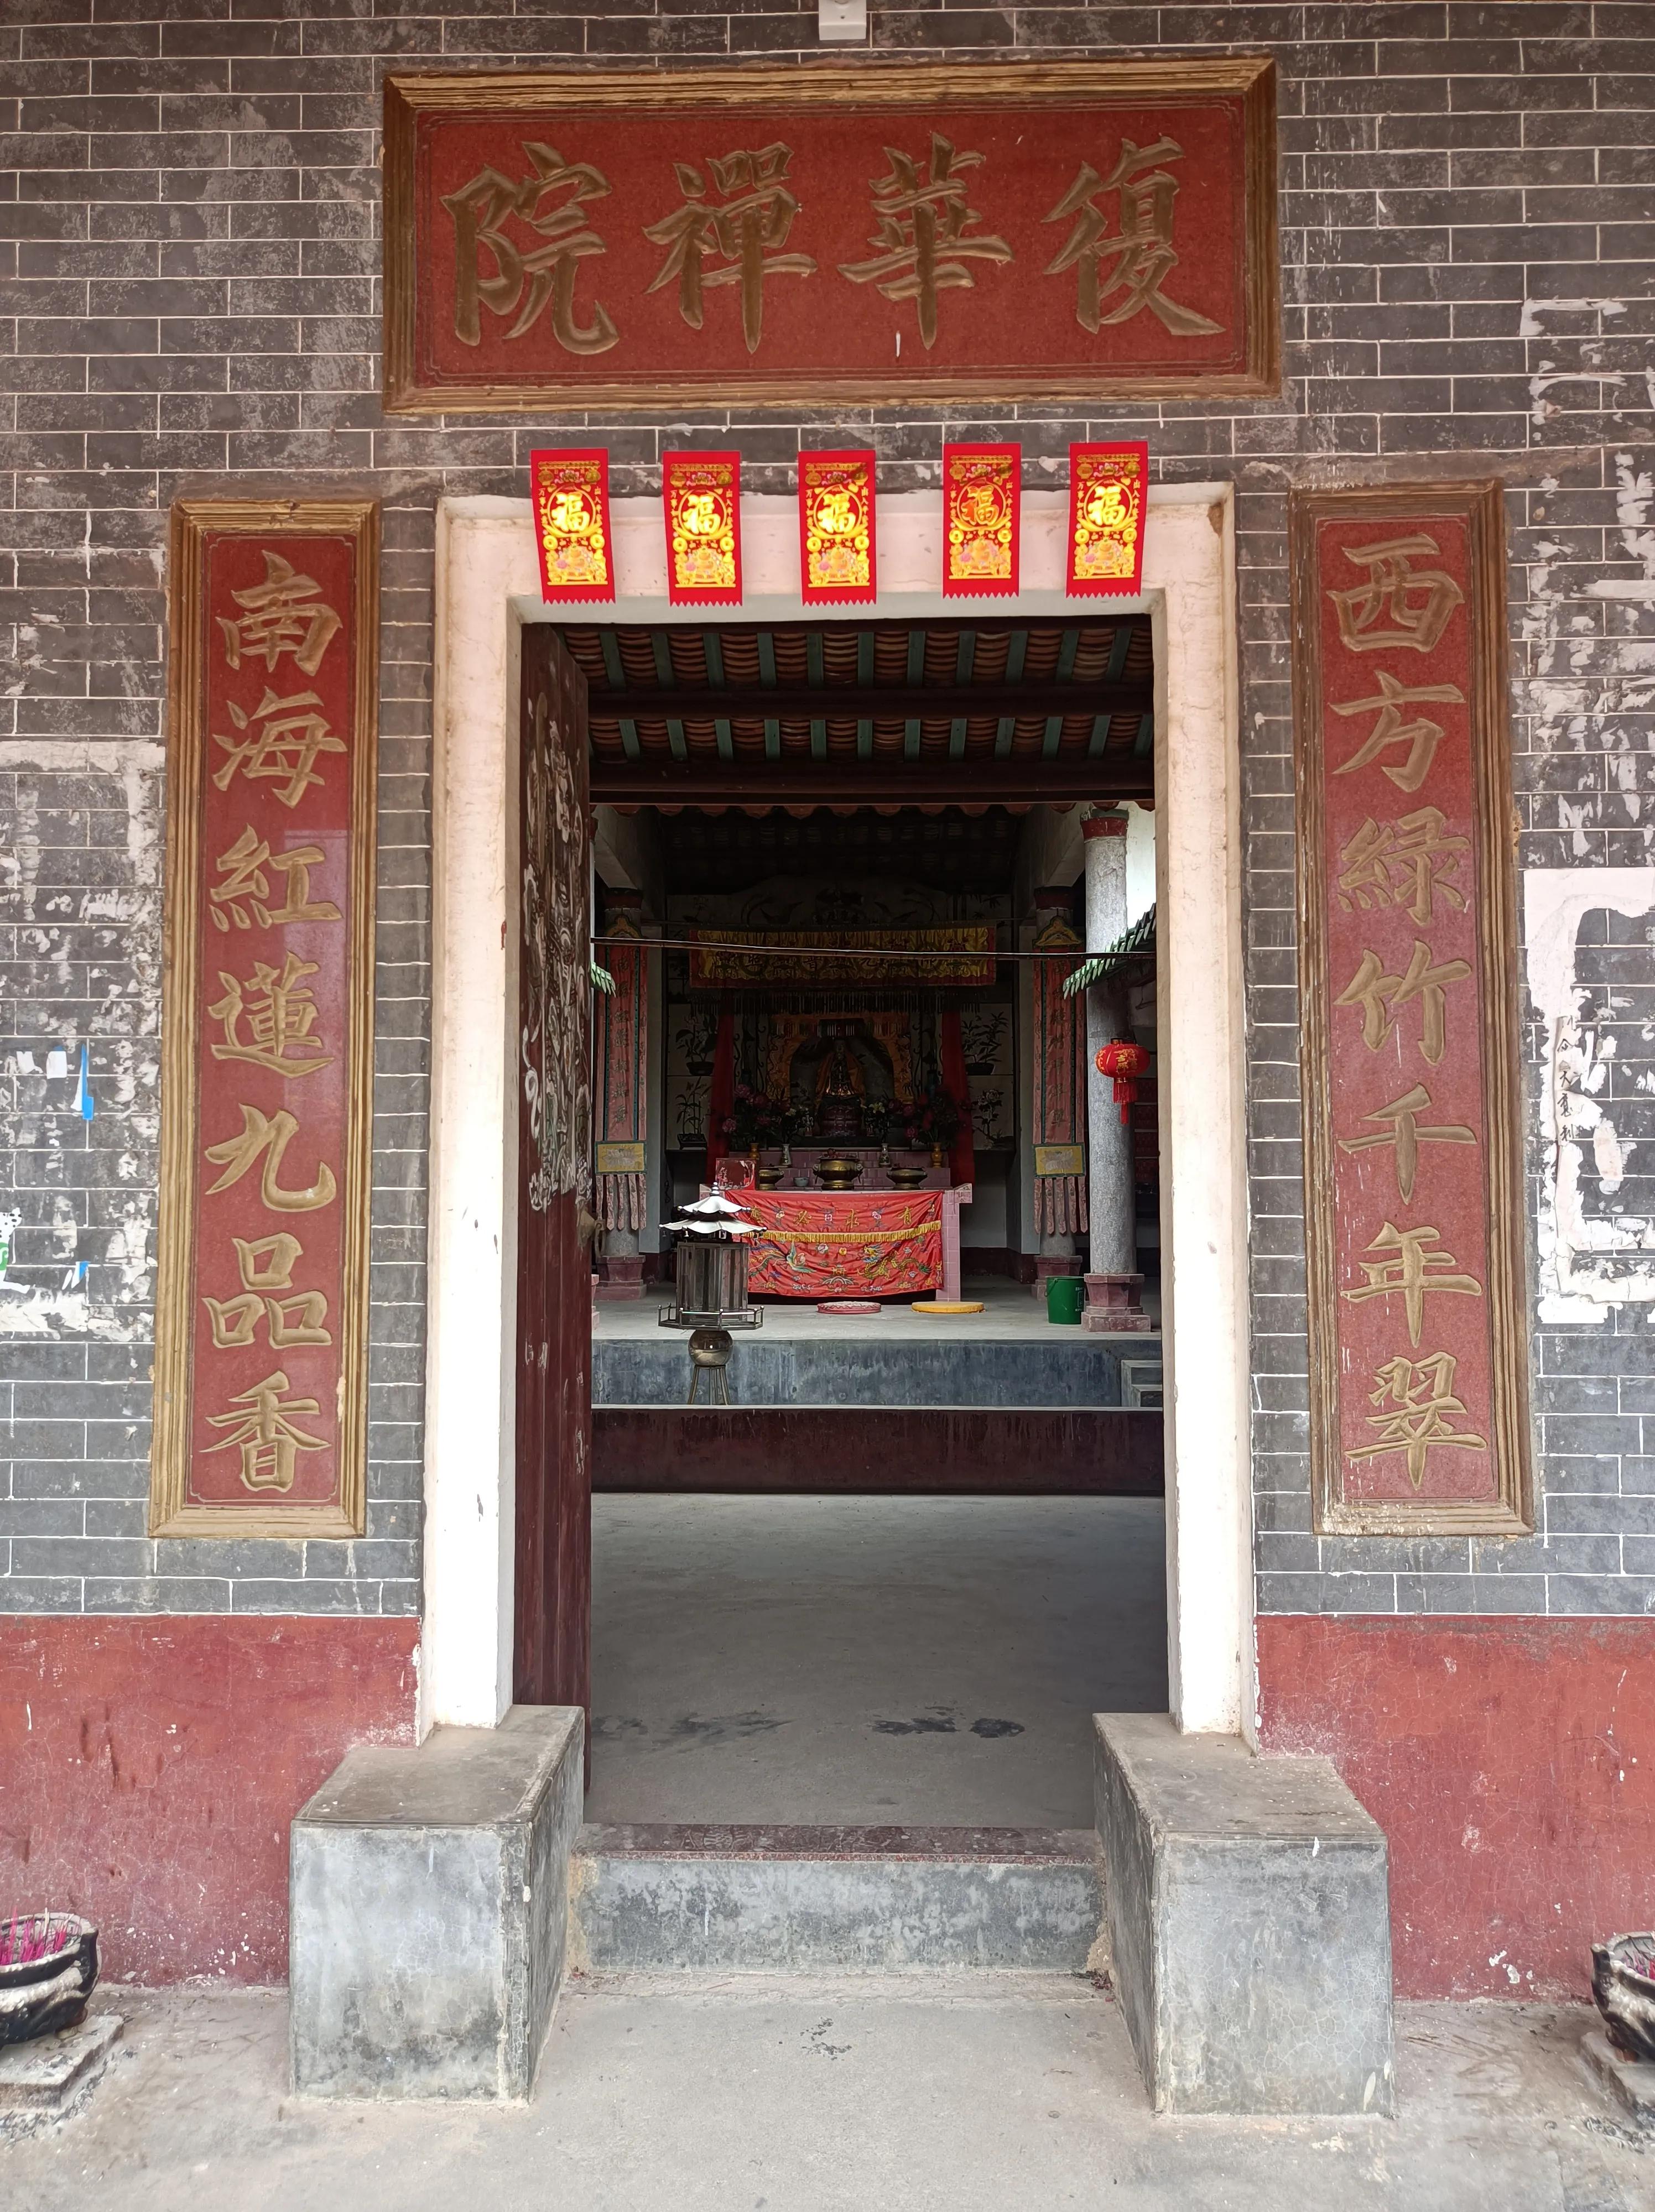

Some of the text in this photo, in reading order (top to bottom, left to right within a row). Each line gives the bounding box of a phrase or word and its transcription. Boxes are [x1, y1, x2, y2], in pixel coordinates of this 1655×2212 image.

[551, 492, 590, 532] 福
[683, 494, 721, 534] 福
[817, 493, 856, 534] 福
[961, 485, 999, 525] 福
[1087, 486, 1127, 526] 福
[202, 550, 347, 1491] 南海紅蓮九品香
[1326, 532, 1489, 1490] 西方綠竹千年翠
